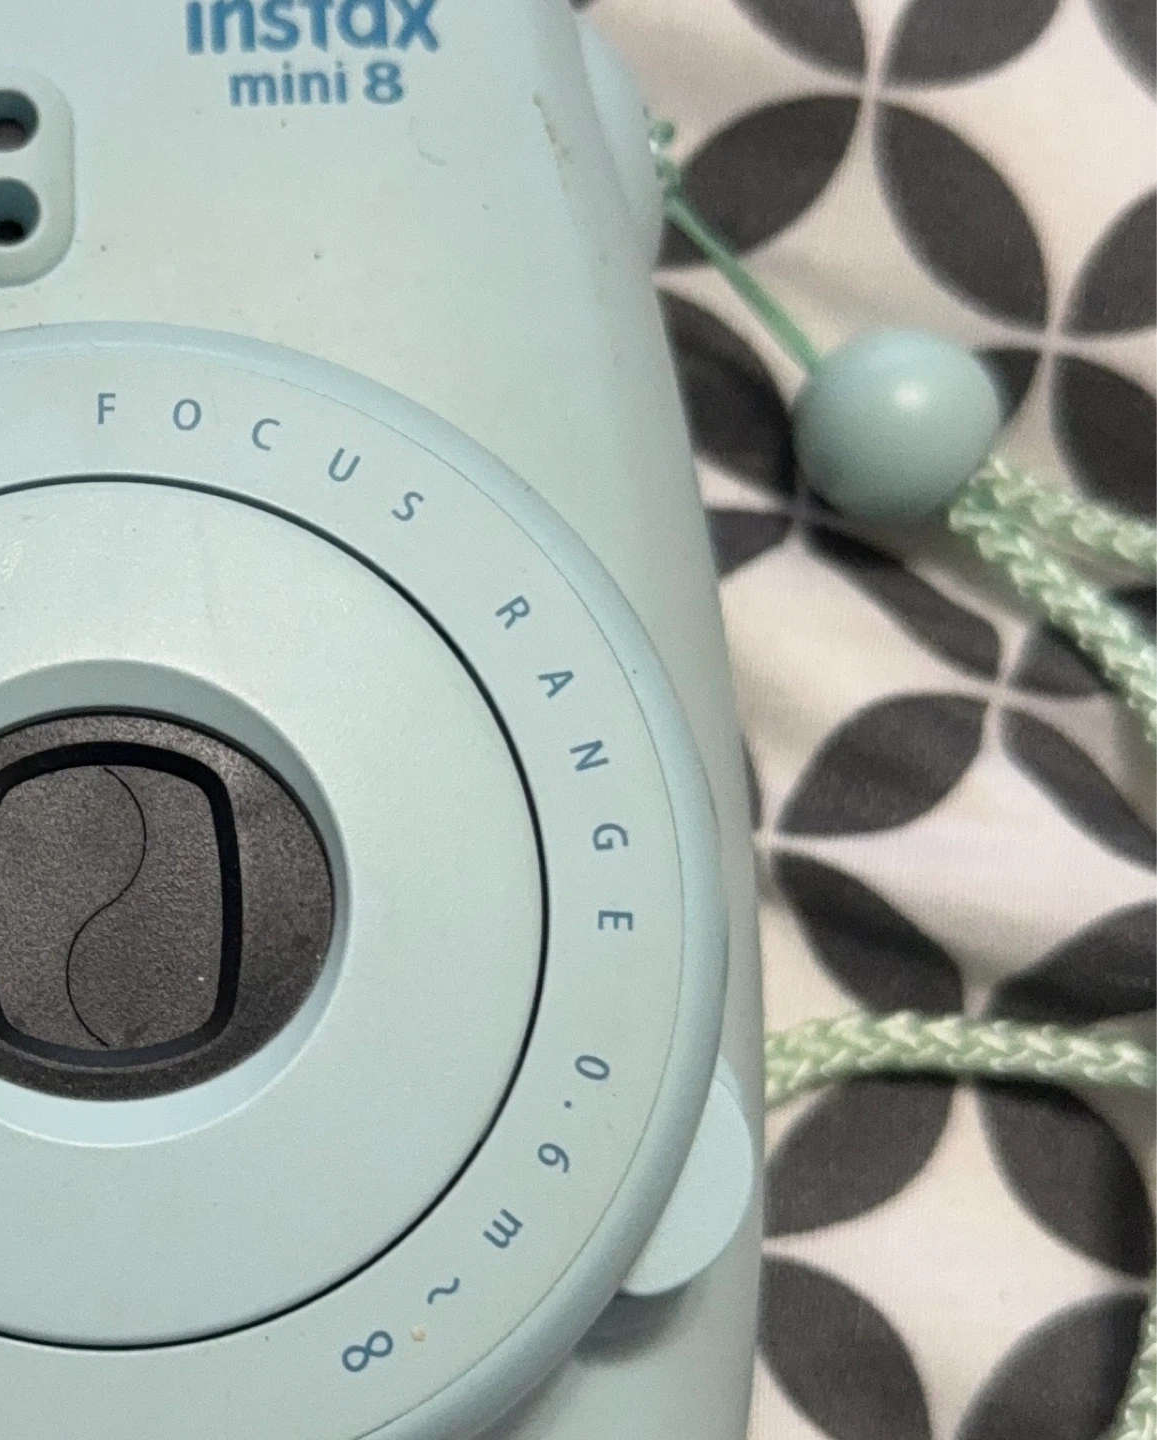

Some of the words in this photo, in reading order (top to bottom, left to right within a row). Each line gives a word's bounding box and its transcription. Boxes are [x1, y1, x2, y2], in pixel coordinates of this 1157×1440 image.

[228, 60, 348, 106] mini
[362, 60, 404, 105] 8
[96, 392, 423, 522] FOCUS
[494, 594, 634, 932] RANGE
